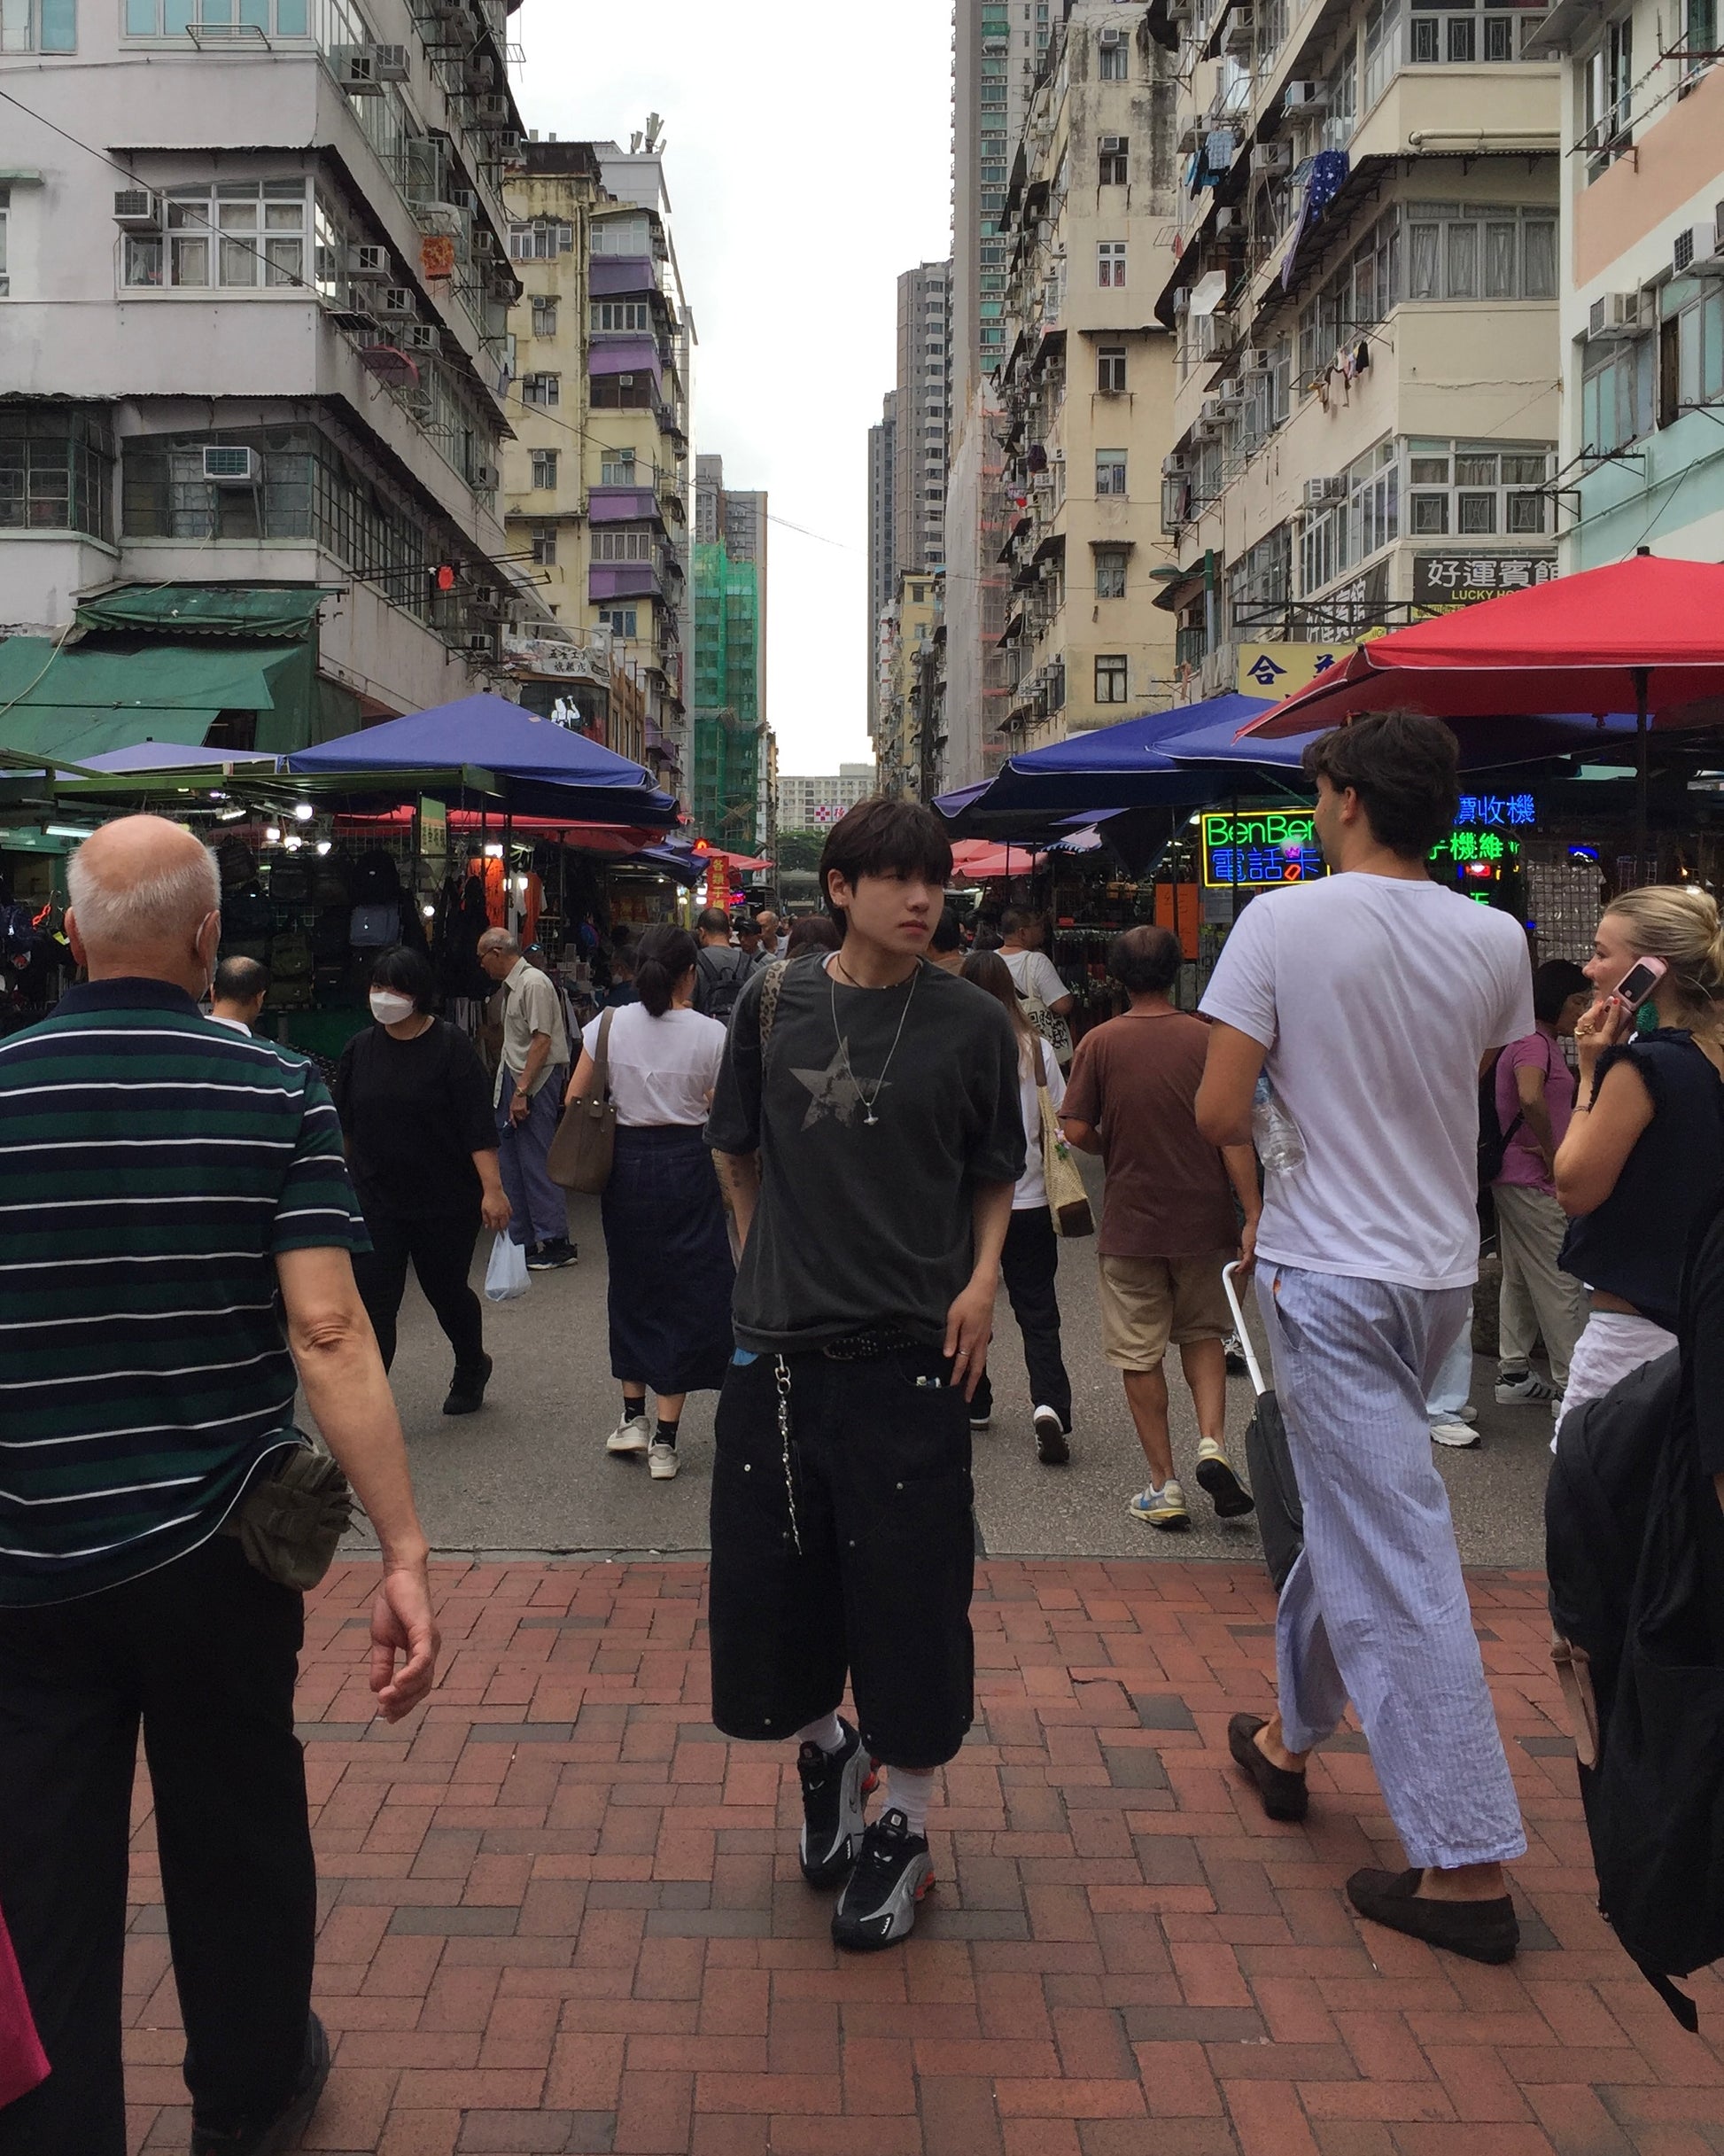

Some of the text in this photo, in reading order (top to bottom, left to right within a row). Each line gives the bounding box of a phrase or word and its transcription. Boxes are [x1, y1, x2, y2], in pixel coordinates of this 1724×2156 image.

[1427, 560, 1559, 588] 好運賓館
[1451, 589, 1494, 600] LUCKY
[1212, 846, 1321, 882] 電話卡
